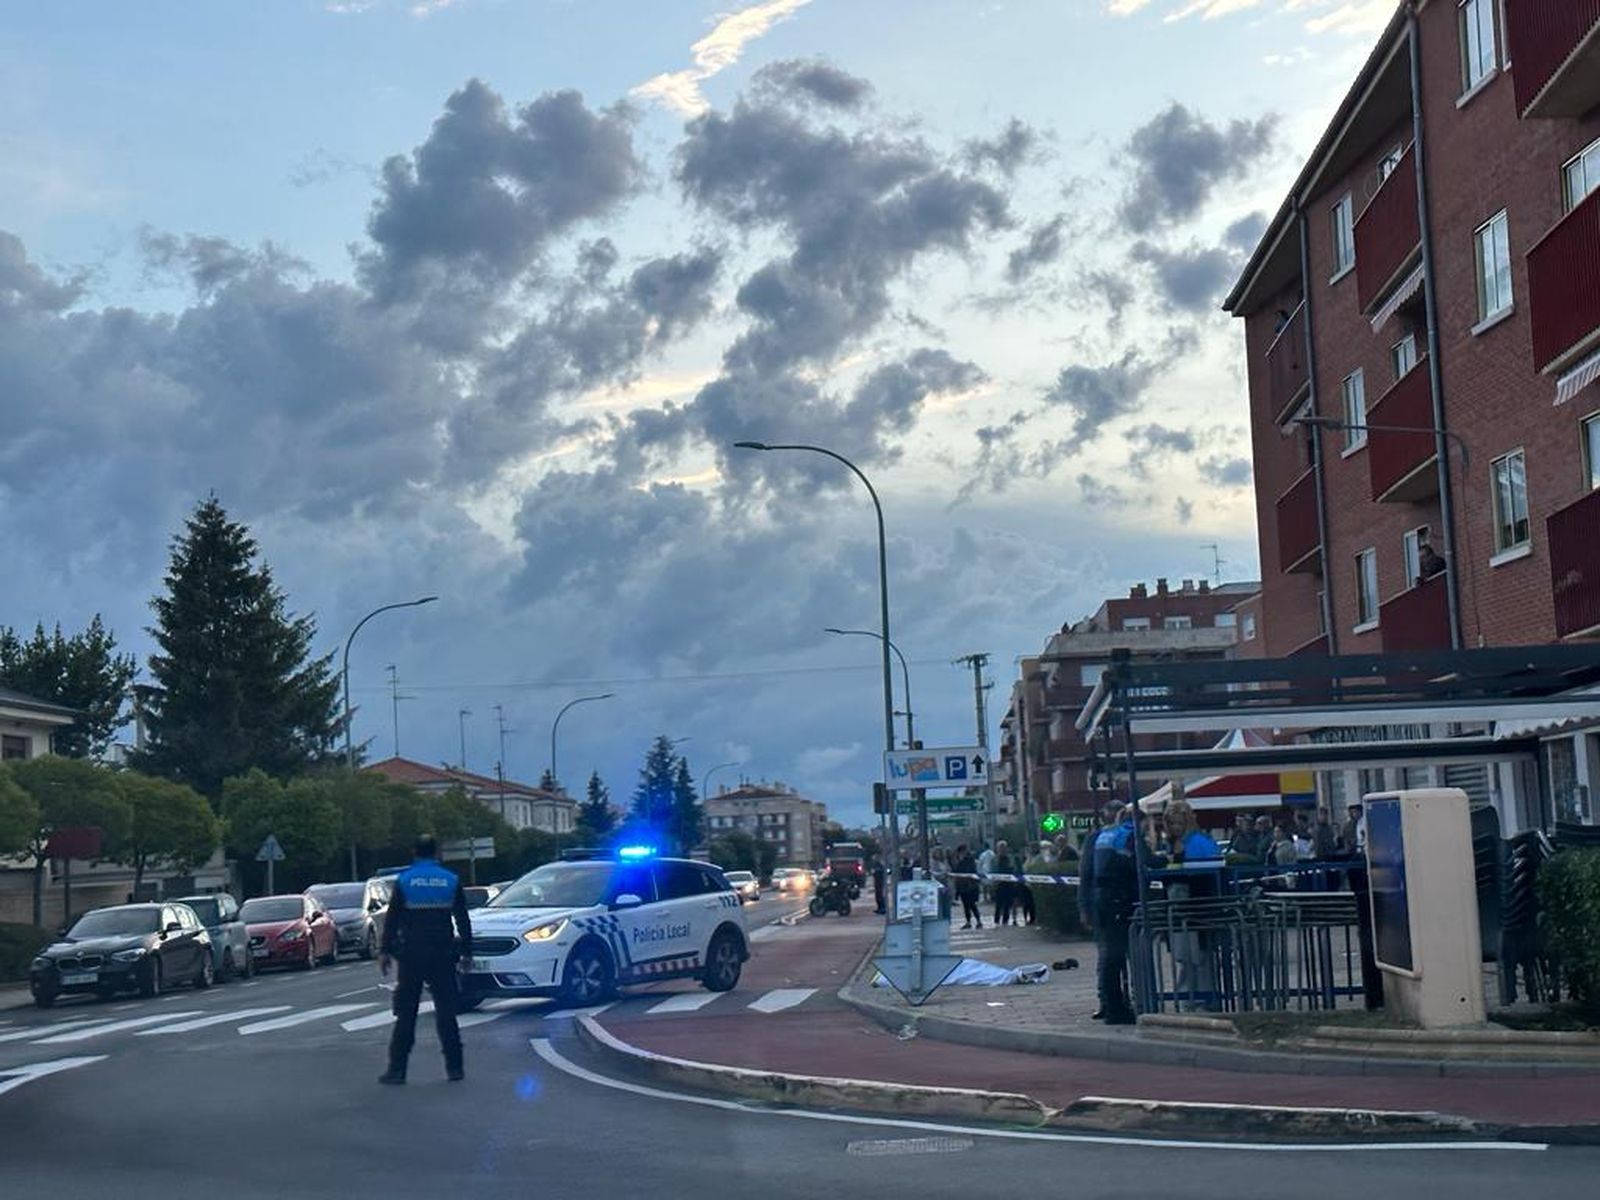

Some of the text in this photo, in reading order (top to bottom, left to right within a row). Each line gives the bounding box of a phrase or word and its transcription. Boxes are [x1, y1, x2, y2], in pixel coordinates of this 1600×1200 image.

[949, 758, 965, 779] P
[719, 894, 739, 908] 112
[666, 921, 691, 939] Local
